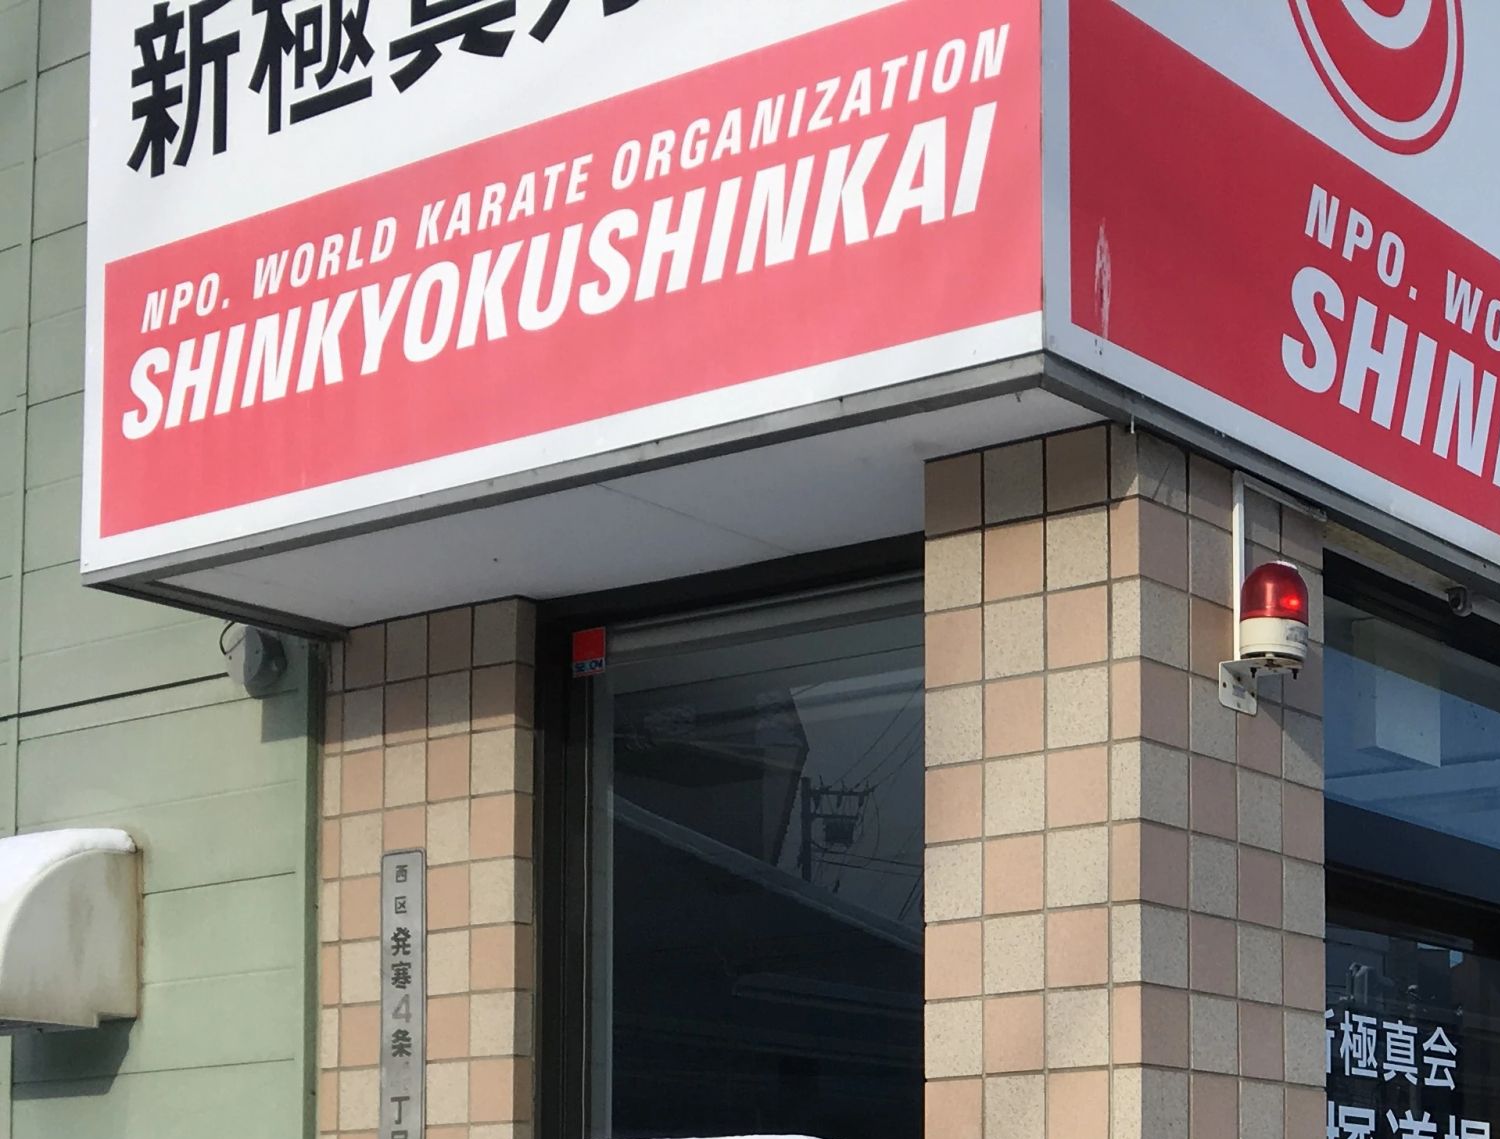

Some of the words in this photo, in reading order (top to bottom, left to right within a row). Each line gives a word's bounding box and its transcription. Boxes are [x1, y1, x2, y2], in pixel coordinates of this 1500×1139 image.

[126, 0, 641, 177] 新極
[140, 272, 230, 334] NPO.
[251, 215, 398, 303] WORLD
[415, 154, 594, 245] KARATE
[611, 23, 1011, 191] ORGANIZATION
[121, 101, 998, 440] SHINKYOKUSHINKAI
[1303, 184, 1418, 301] NPO.
